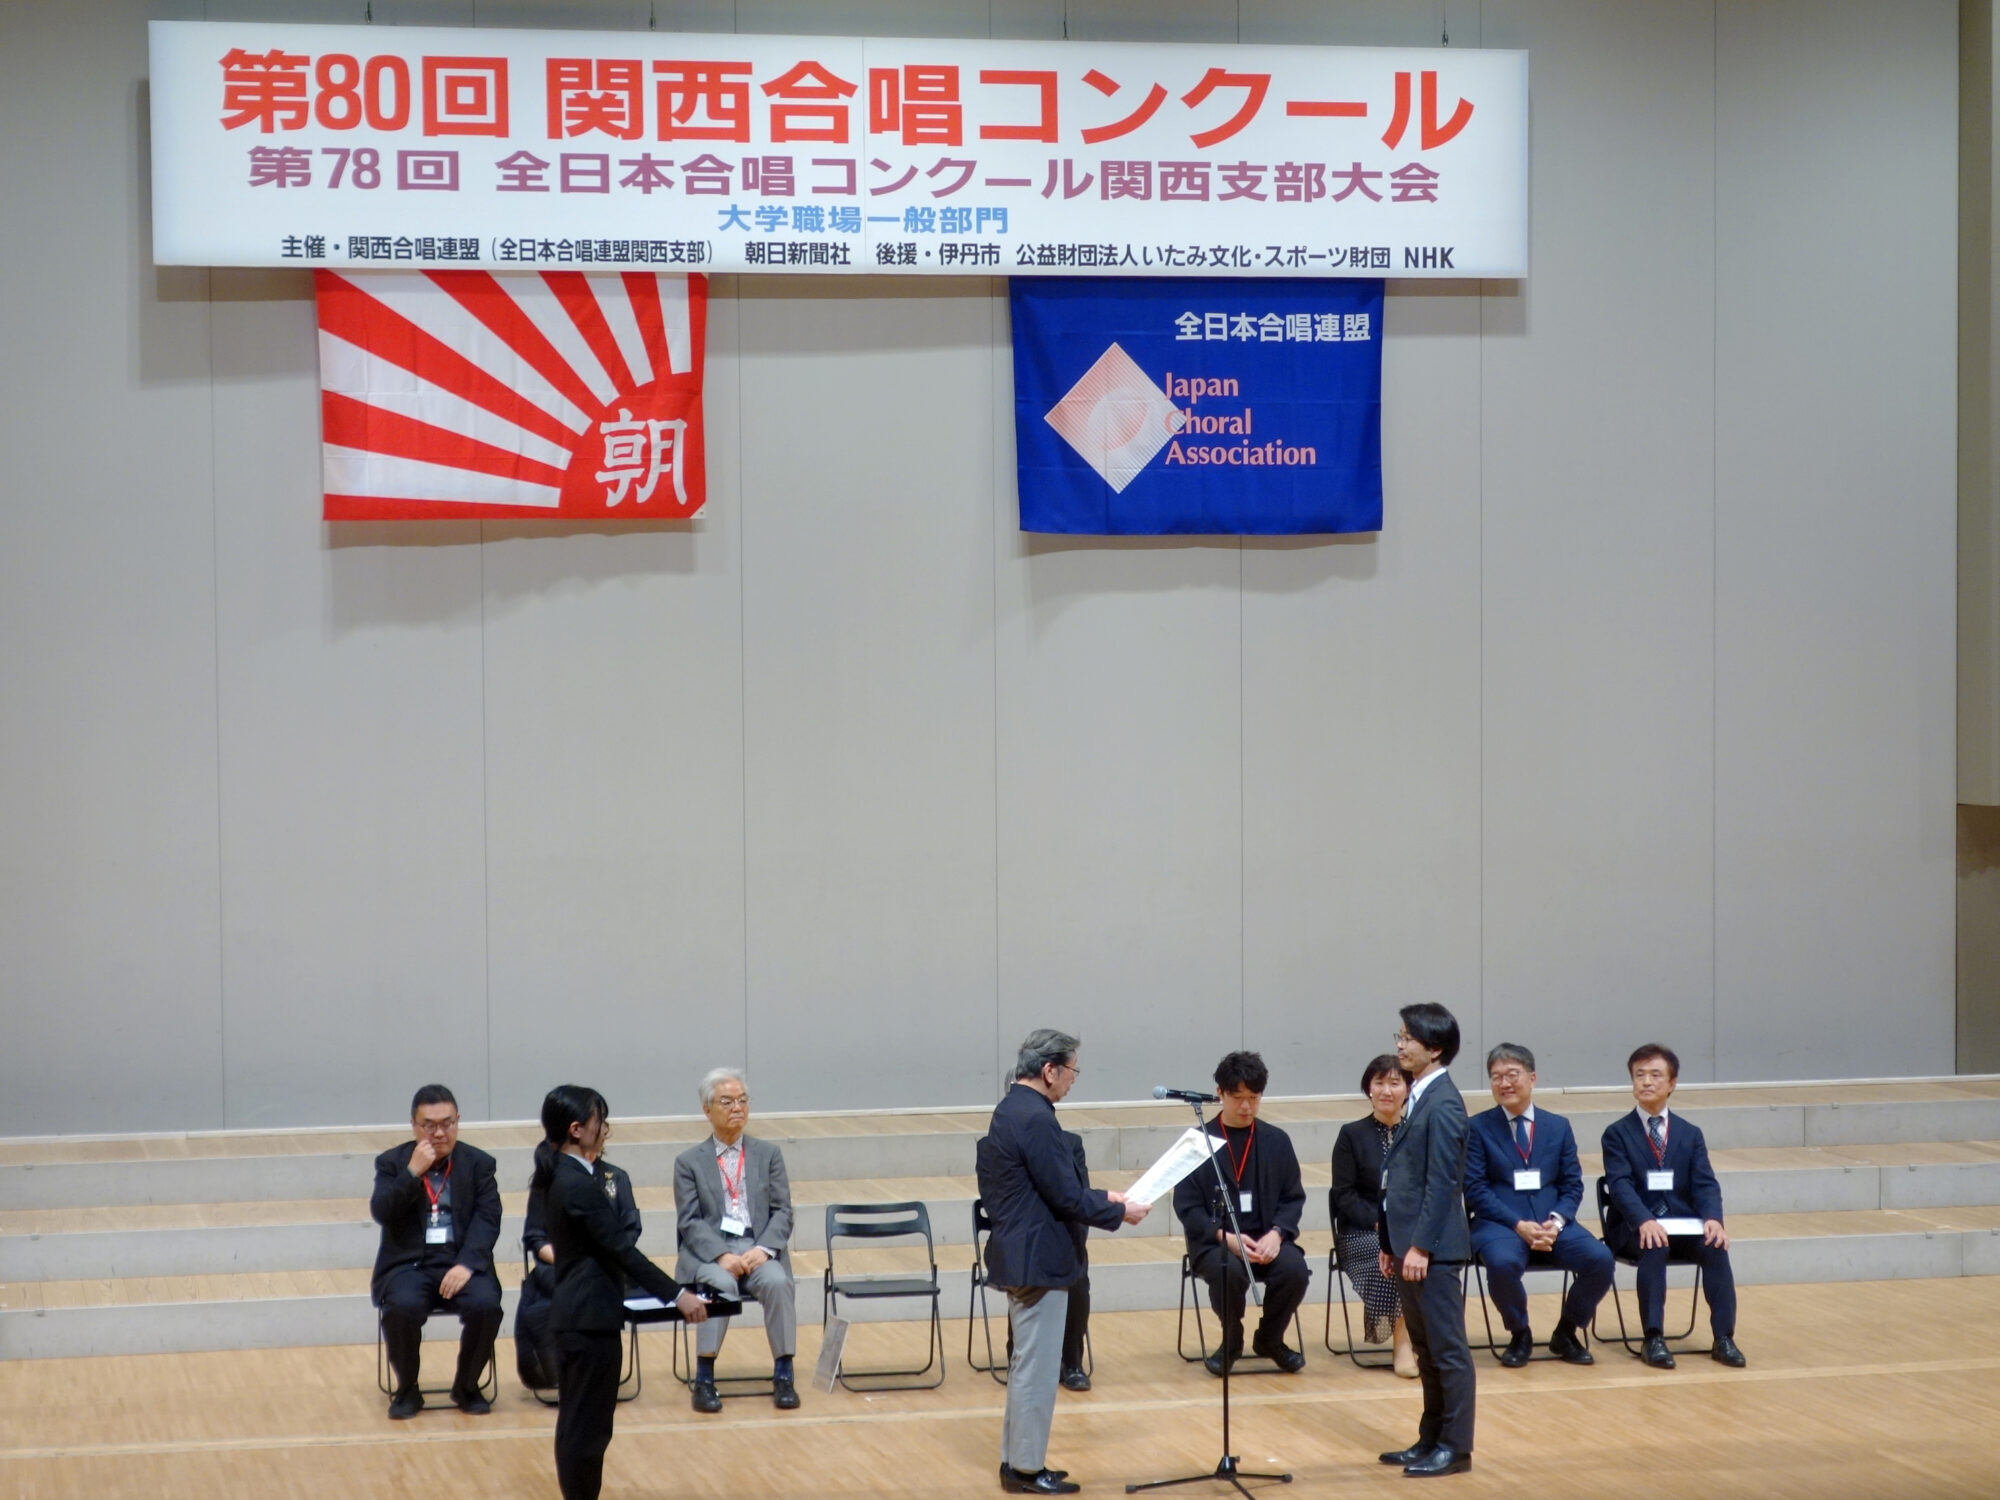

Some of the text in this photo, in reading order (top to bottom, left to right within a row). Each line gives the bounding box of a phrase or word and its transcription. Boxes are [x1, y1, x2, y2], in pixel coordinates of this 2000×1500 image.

[219, 48, 1475, 151] 第80回 関西合唱コンクール
[247, 145, 1440, 204] 第78回 全日本合唱コンクール関西支部大会
[717, 203, 1009, 236] 大学職場一般部門
[745, 241, 851, 266] 朝日新聞社
[876, 242, 1001, 267] 後援・伊丹市
[1016, 243, 1390, 270] 公益財団法人いたみ文化・スポーツ財団
[1404, 246, 1455, 270] NHK
[1174, 311, 1371, 343] 全日本合唱連盟
[1165, 372, 1239, 402] Japan
[1164, 408, 1252, 435] Choral
[594, 407, 688, 508] 朝
[1164, 440, 1316, 466] Association
